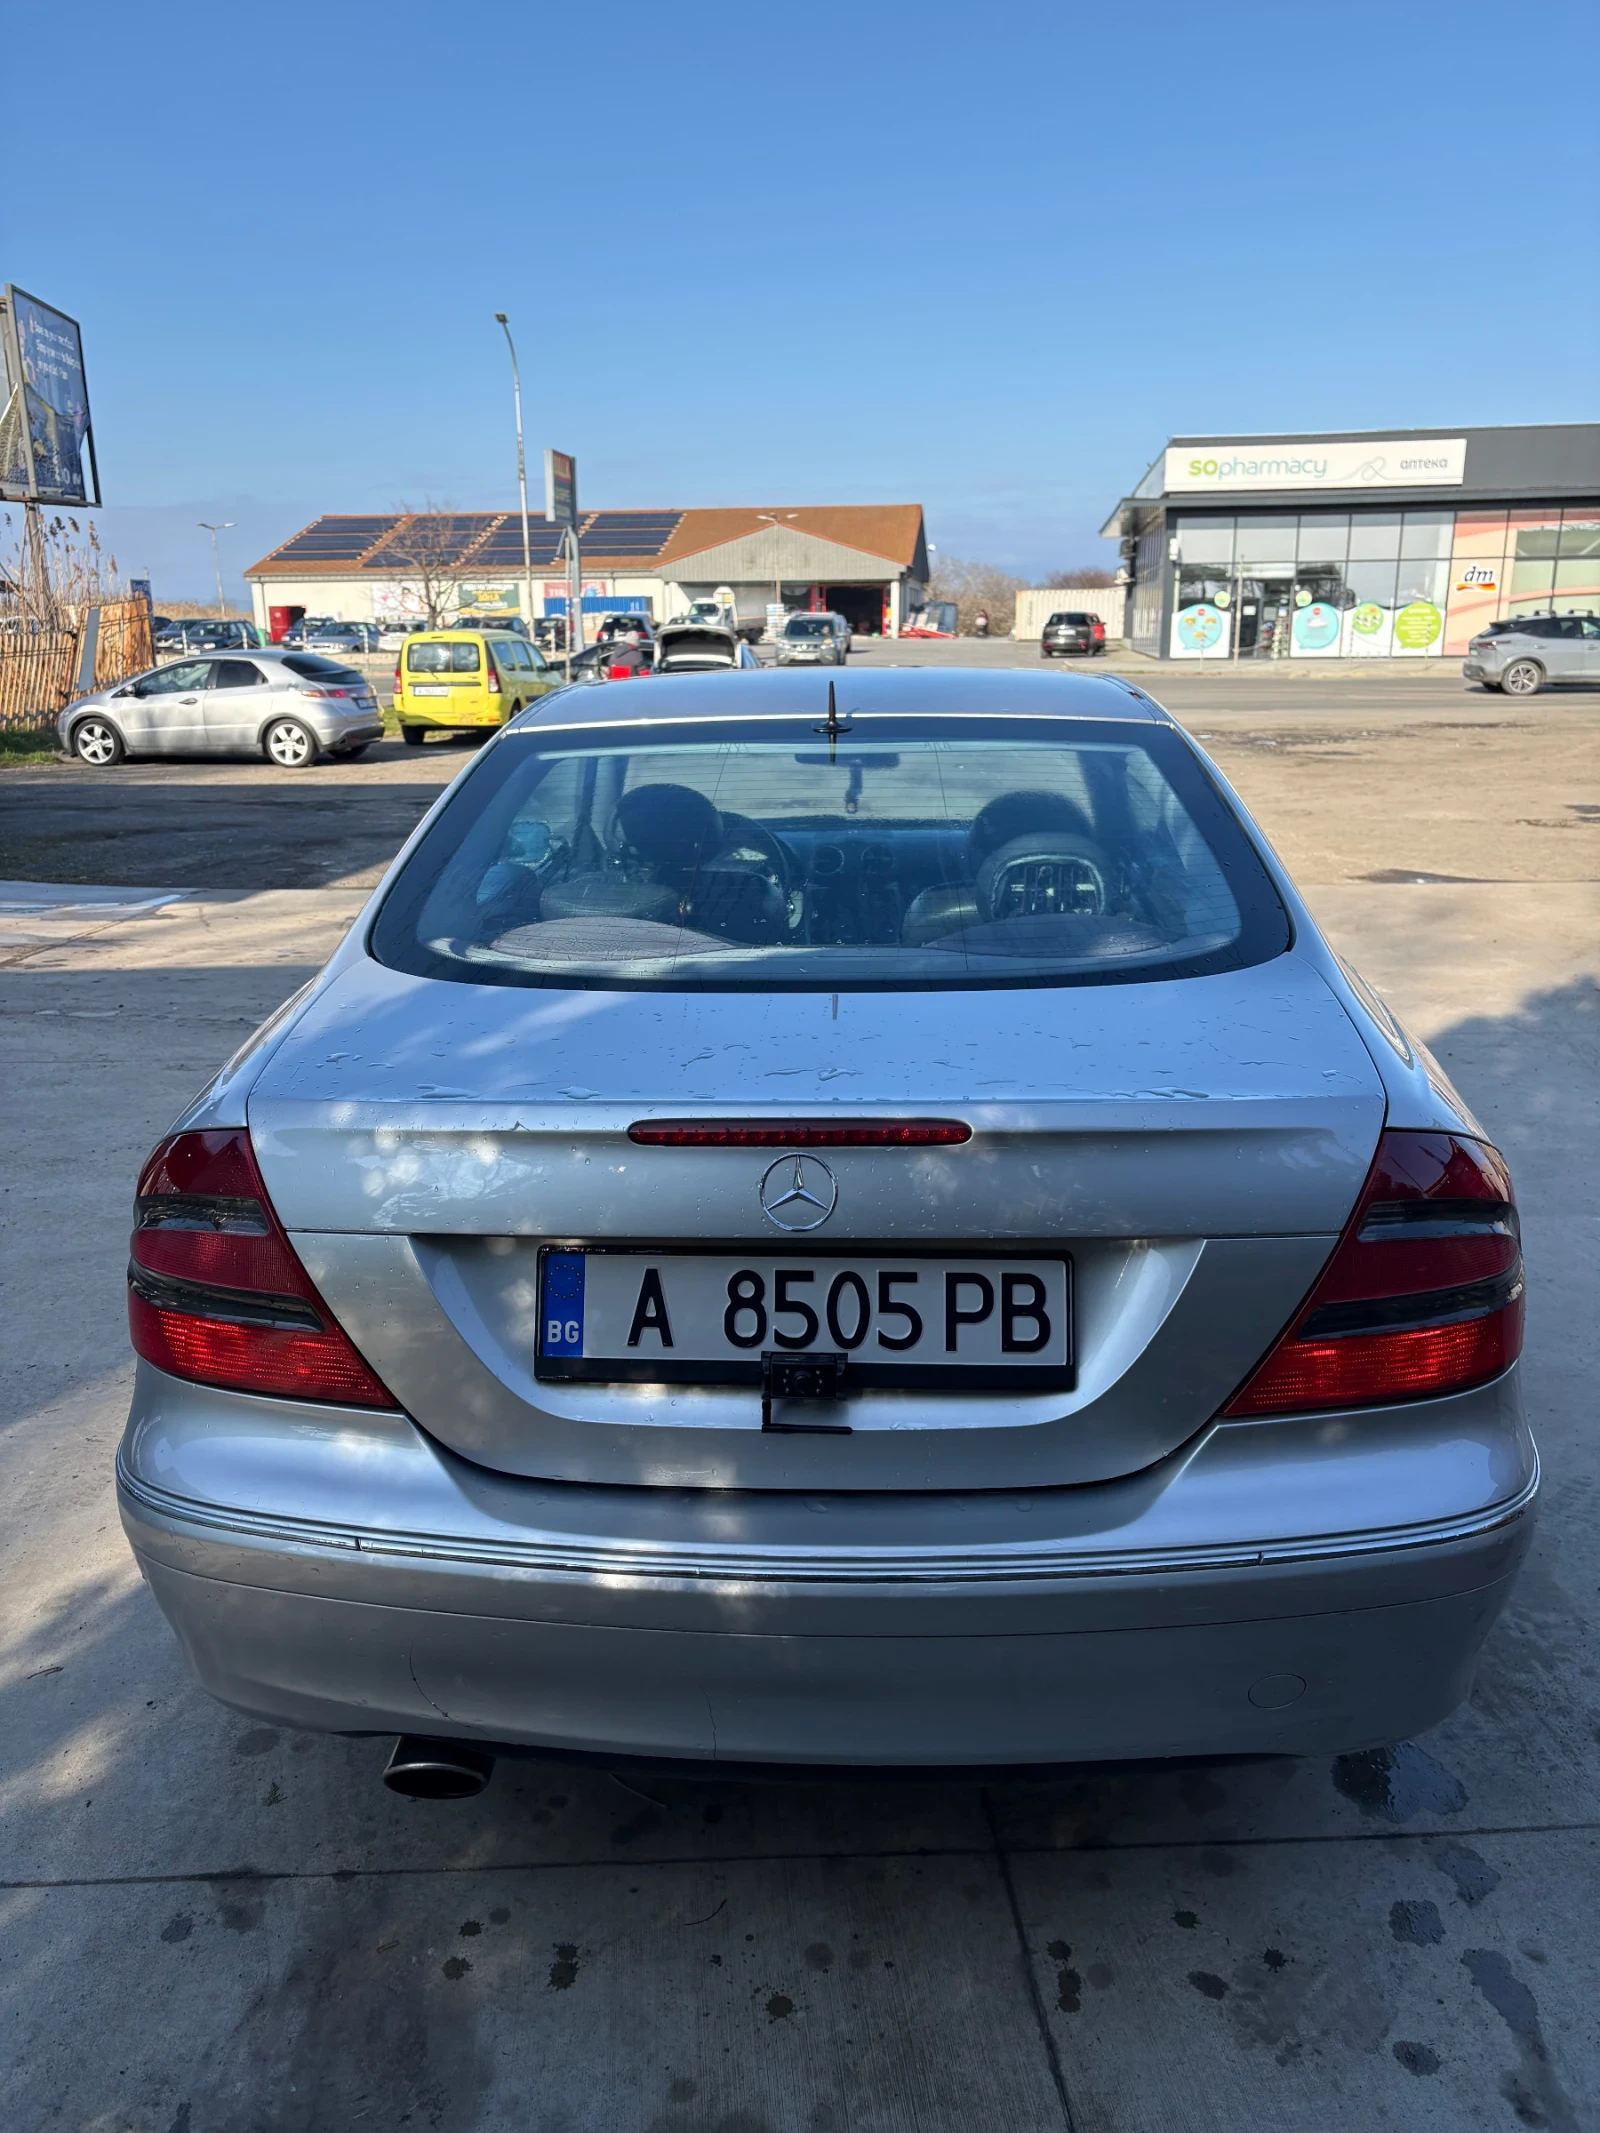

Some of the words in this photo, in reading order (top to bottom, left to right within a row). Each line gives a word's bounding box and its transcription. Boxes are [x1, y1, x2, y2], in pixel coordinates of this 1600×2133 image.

[1189, 457, 1327, 480] sopharmacy
[1400, 459, 1448, 469] аптека
[1464, 566, 1493, 582] dm
[627, 1268, 674, 1347] A
[724, 1269, 923, 1350] 8505
[945, 1271, 1051, 1353] PB
[547, 1320, 579, 1343] BG
